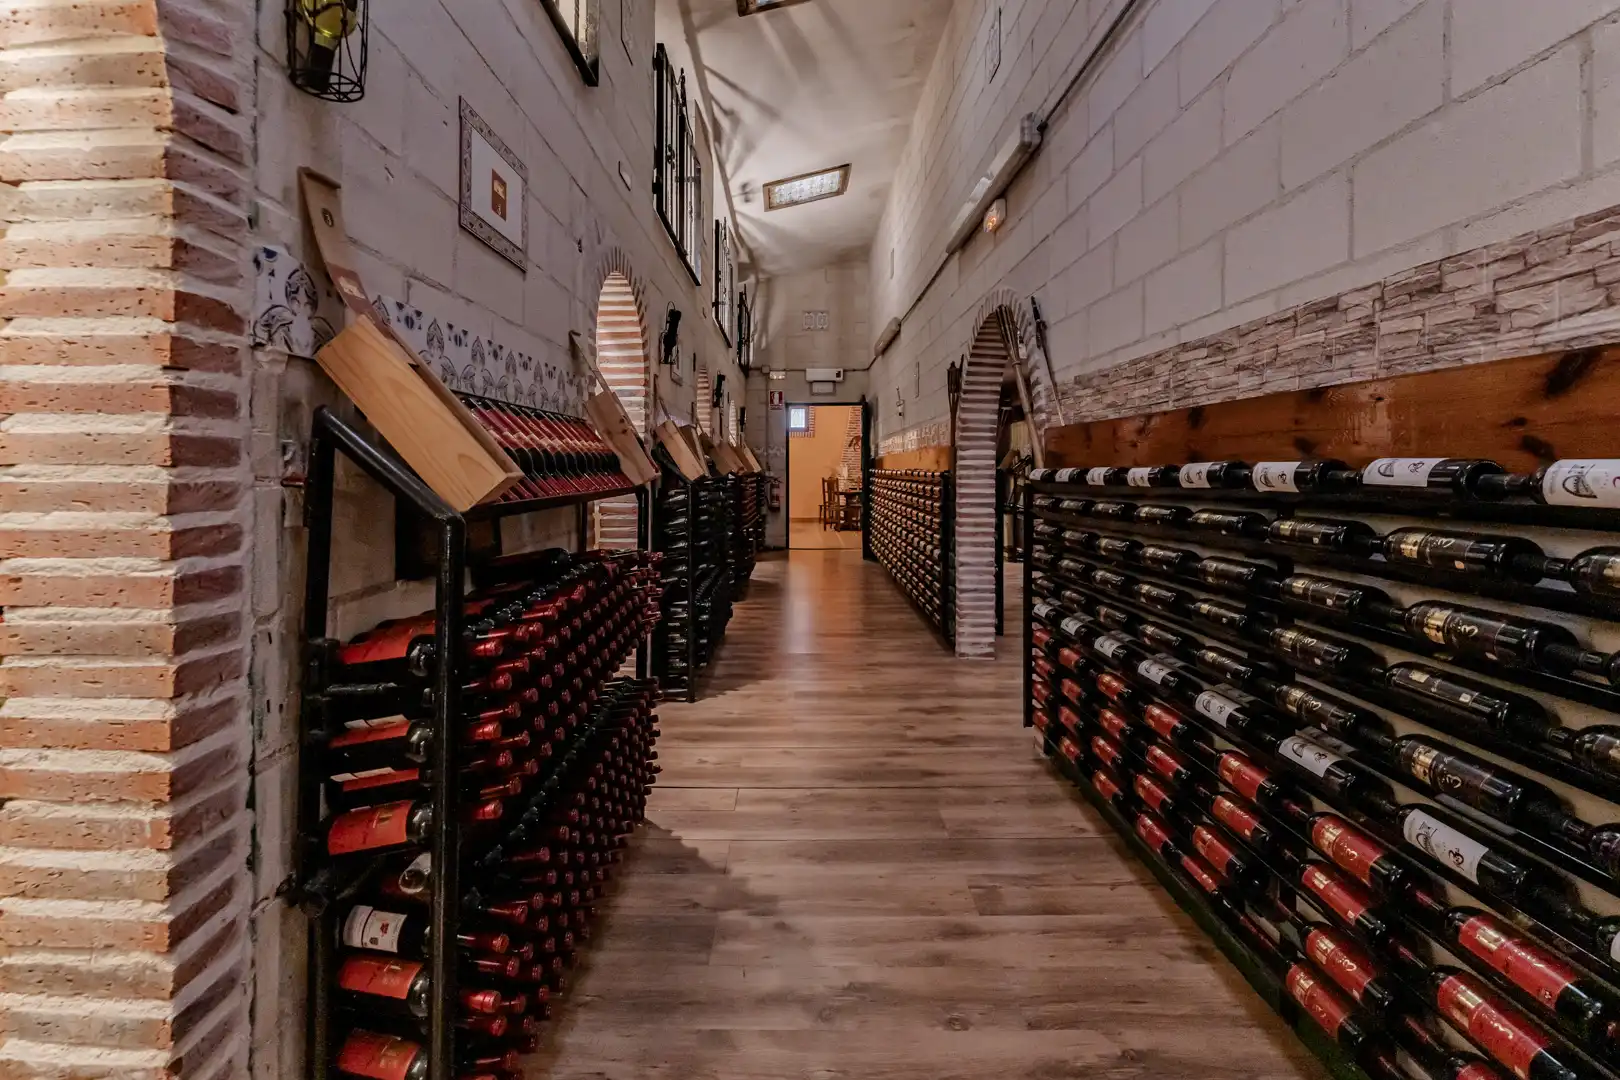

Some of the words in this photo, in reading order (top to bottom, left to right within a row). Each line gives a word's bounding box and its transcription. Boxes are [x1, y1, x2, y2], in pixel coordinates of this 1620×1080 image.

[1461, 624, 1478, 637] 3
[1445, 773, 1462, 789] 3
[1342, 958, 1357, 972] 3
